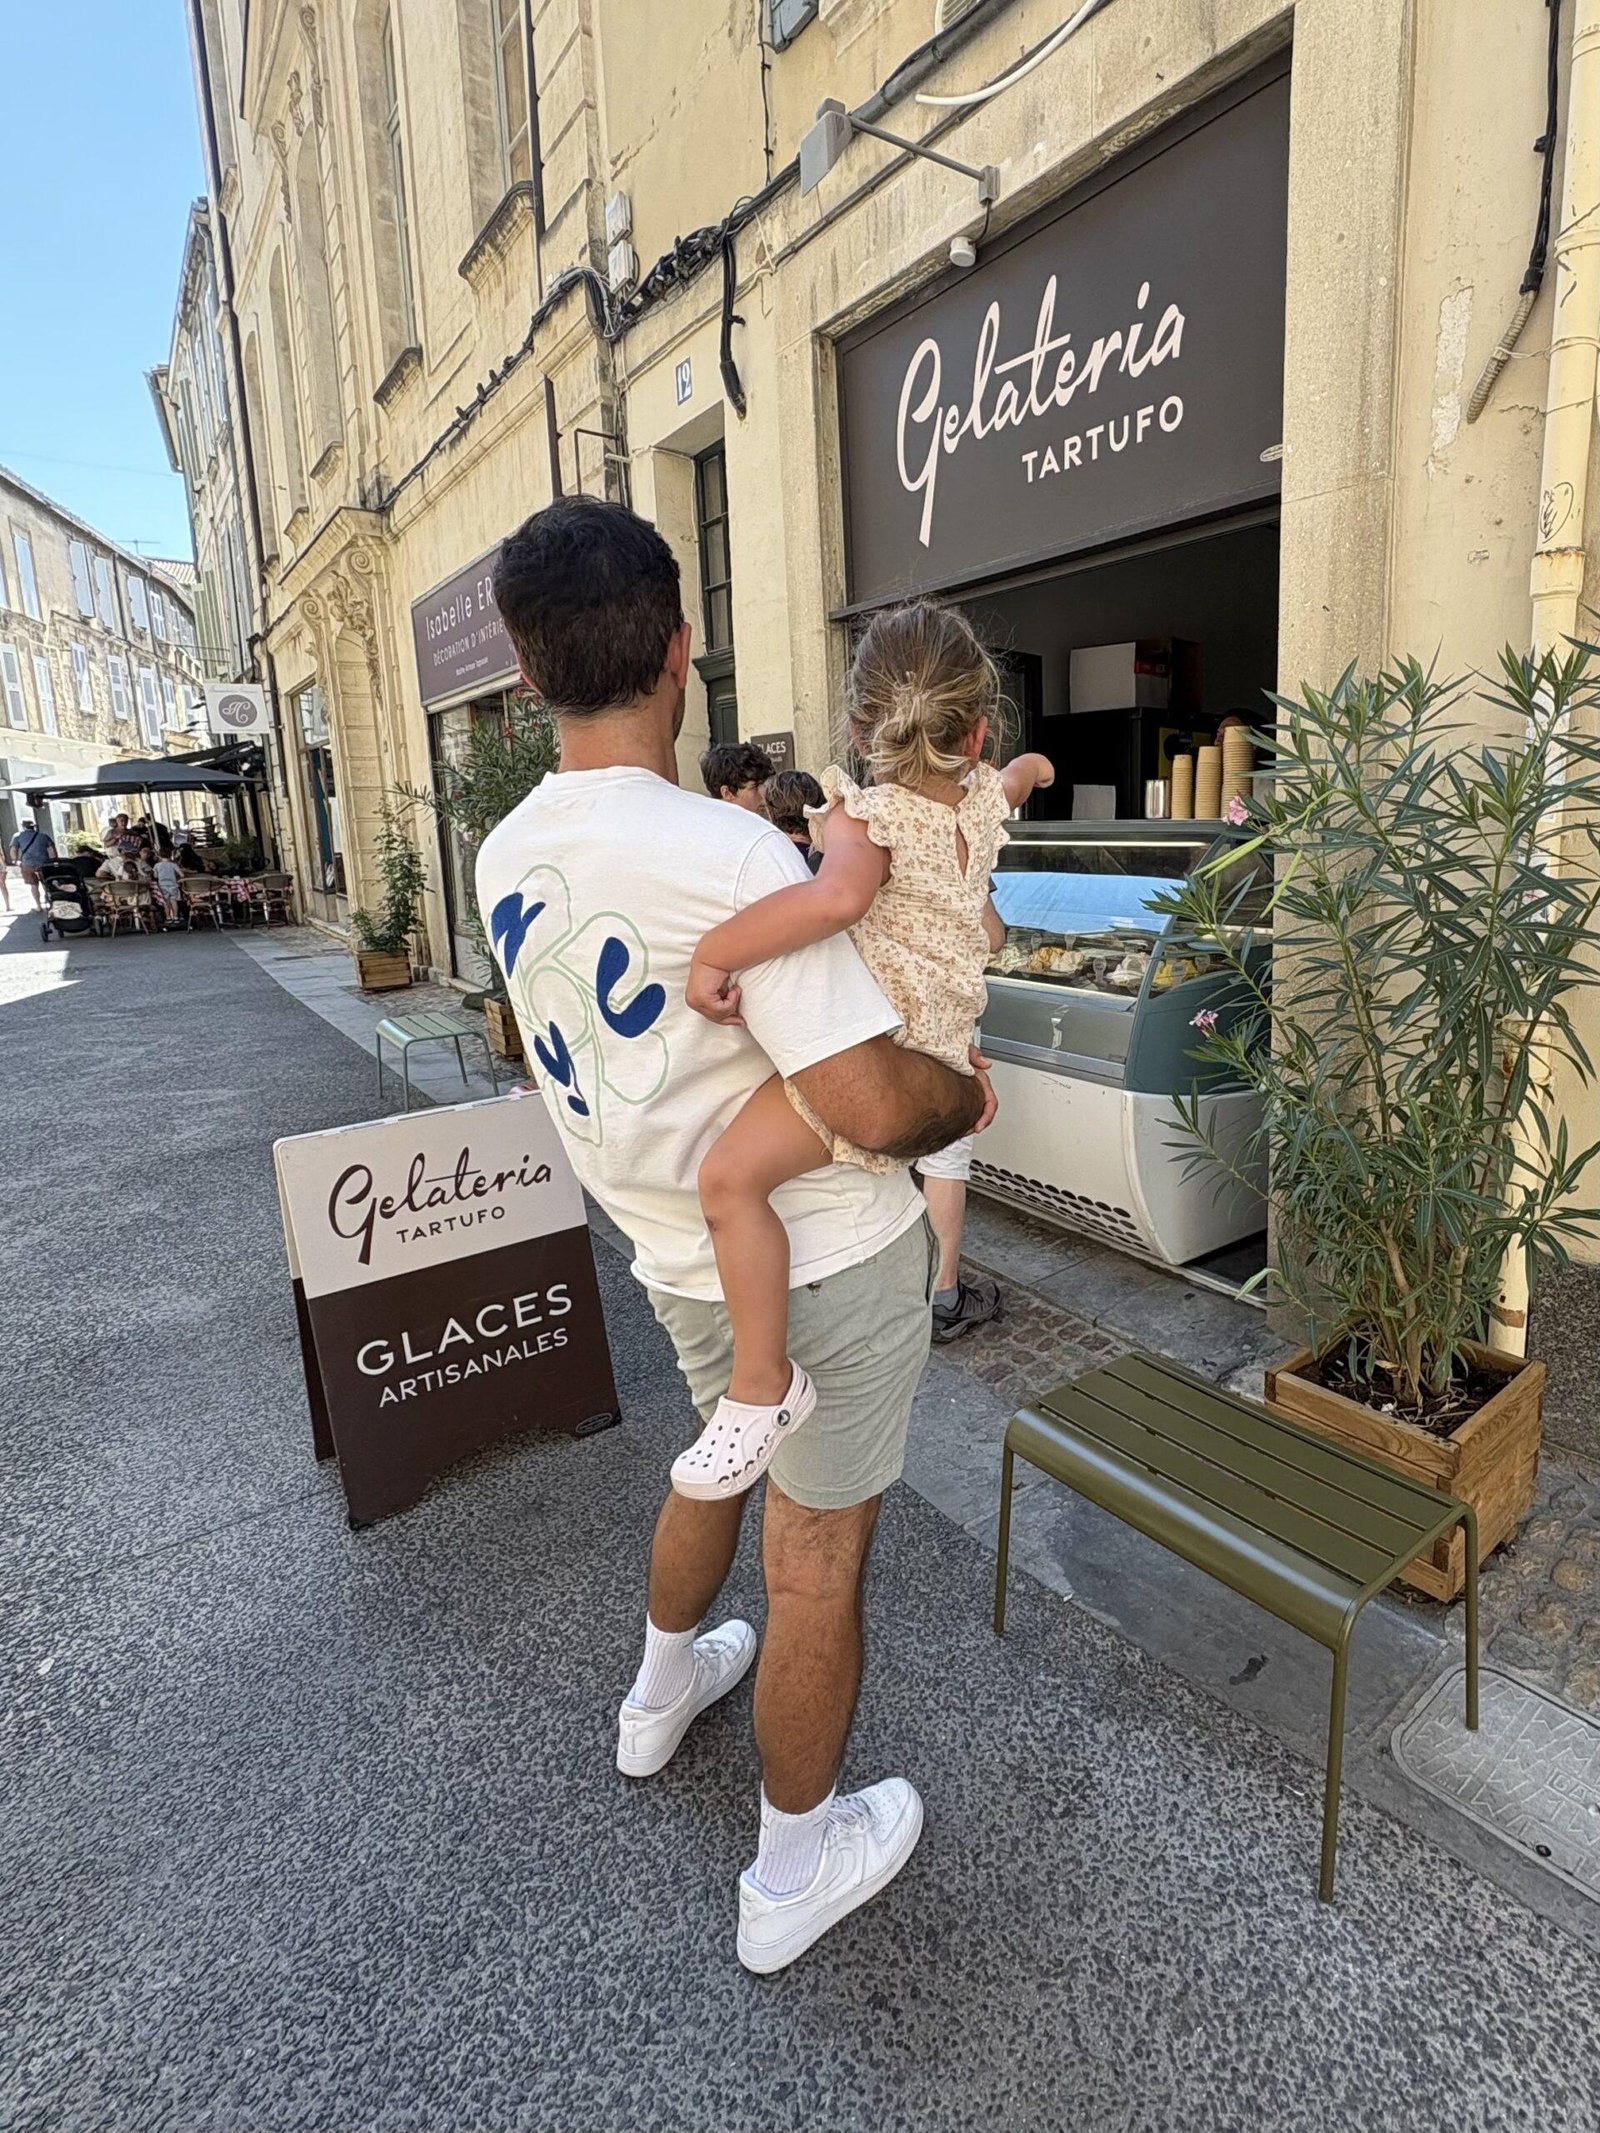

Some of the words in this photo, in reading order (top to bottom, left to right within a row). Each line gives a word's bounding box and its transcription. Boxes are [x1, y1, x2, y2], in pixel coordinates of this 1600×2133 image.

[677, 362, 692, 402] 12
[896, 273, 1186, 547] Gelateria
[1021, 395, 1185, 483] TARTUFO
[426, 594, 472, 641] Isabelle
[477, 576, 493, 611] ER
[433, 636, 471, 667] DÉCORATION
[471, 617, 505, 648] D'INTÉRIE
[757, 741, 787, 755] LACES
[327, 1146, 552, 1266] Gelateria
[396, 1206, 506, 1244] TARTUFO
[356, 1283, 573, 1377] GLACES
[378, 1327, 569, 1408] ARTISANALES
[1553, 1774, 1592, 1805] GA
